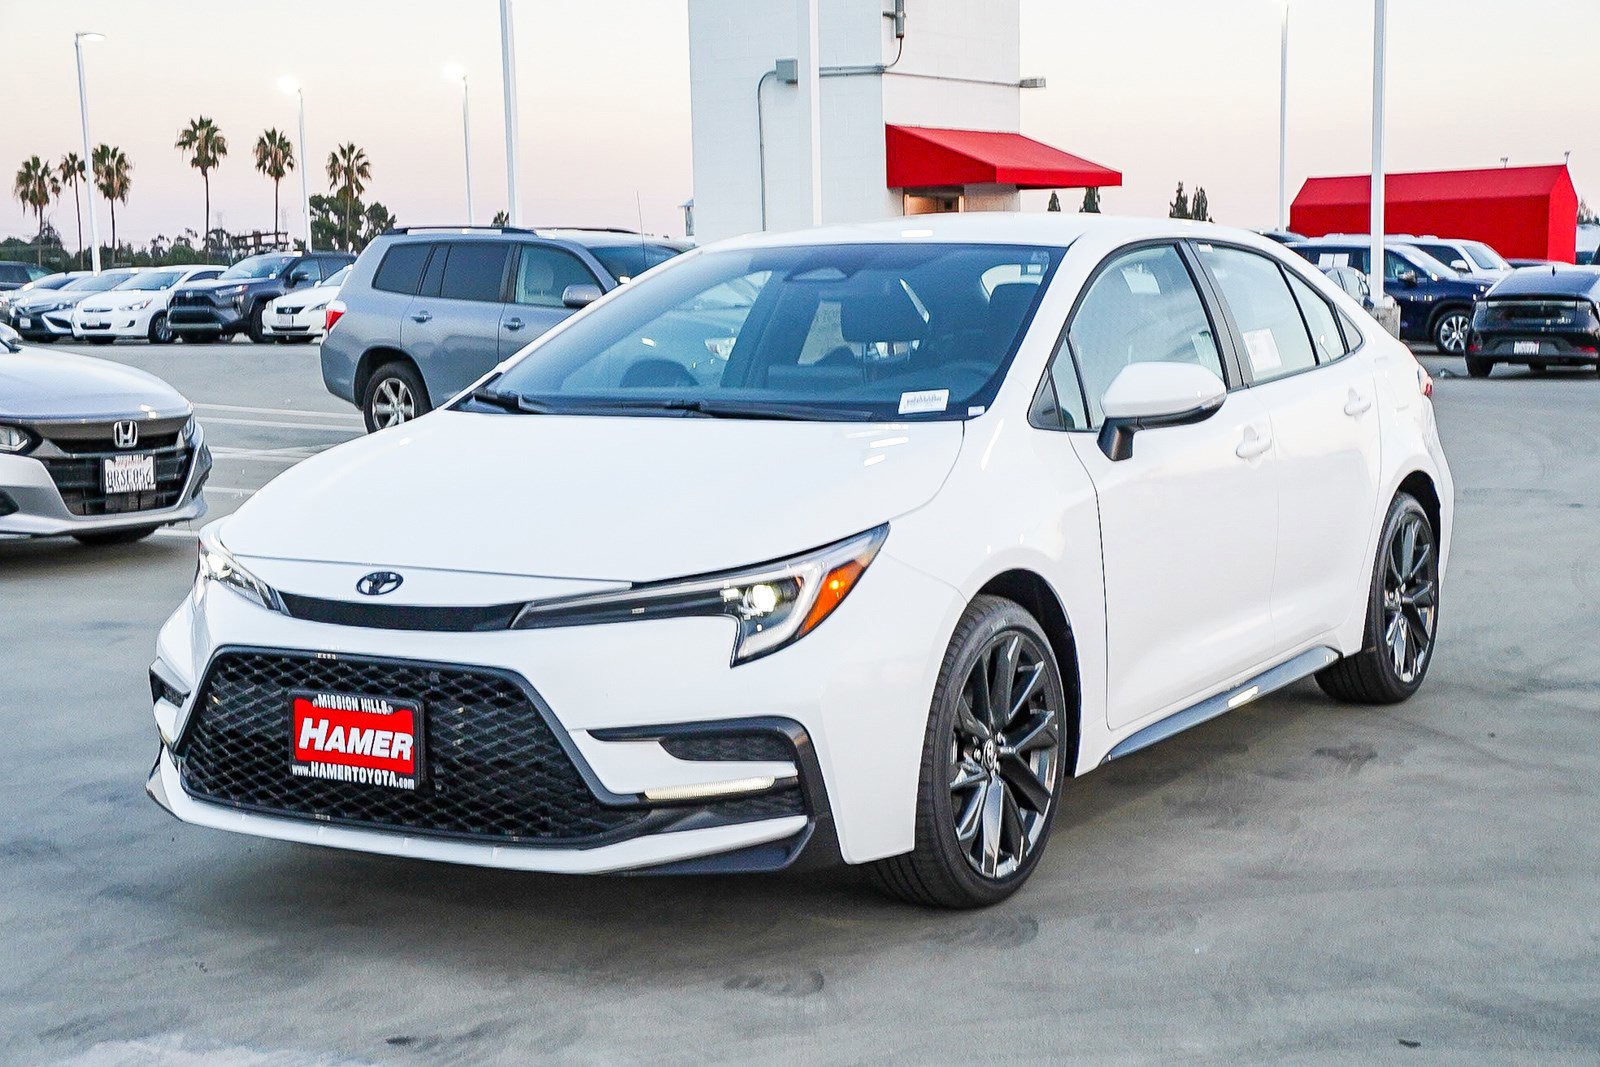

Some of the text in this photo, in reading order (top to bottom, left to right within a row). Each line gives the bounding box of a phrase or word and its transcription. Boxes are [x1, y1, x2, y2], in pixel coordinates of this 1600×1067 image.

[317, 694, 388, 715] MISSION HILLS
[298, 717, 414, 761] HAMER
[292, 761, 414, 790] www.HAMERTOYOTA.com
